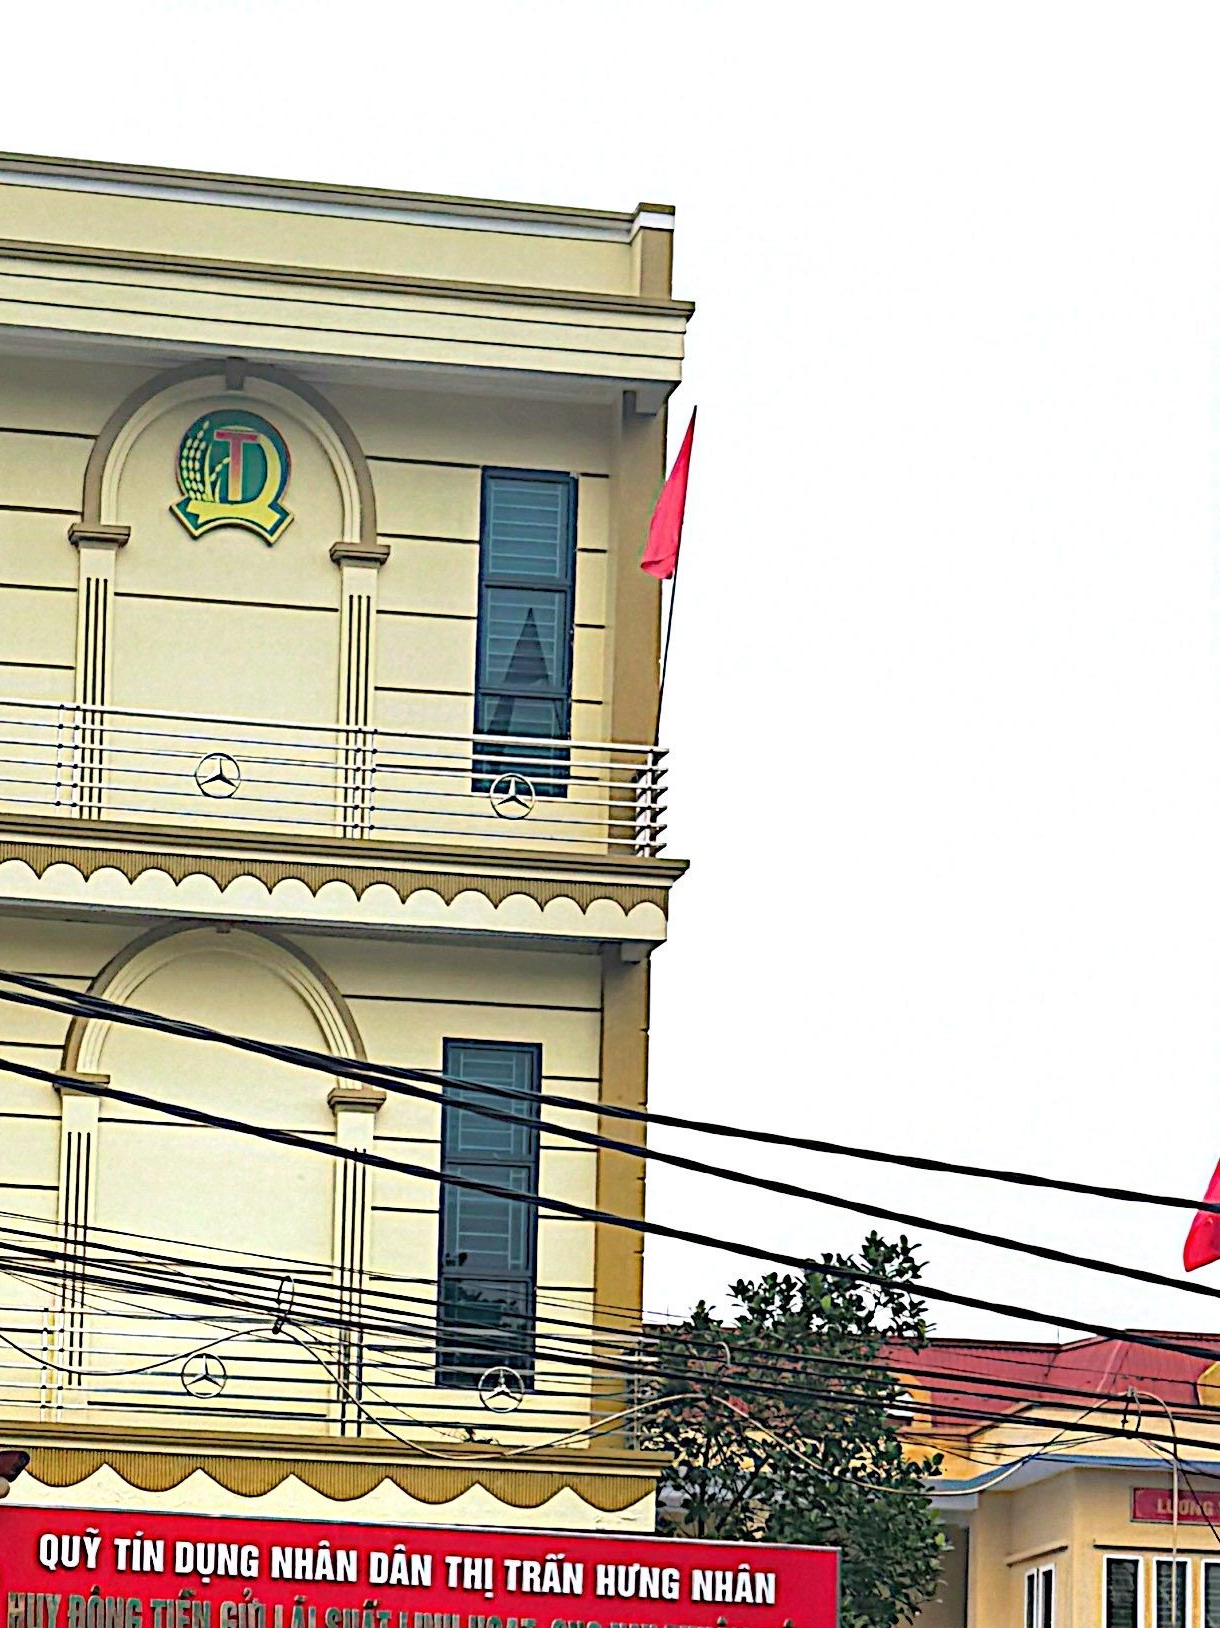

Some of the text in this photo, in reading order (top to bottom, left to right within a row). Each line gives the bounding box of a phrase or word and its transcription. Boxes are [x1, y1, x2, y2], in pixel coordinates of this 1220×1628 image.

[39, 1527, 776, 1604] QUỸ TÍN DỤNG NHÂN DÂN THỊ TRẤN HƯNG NHÂN
